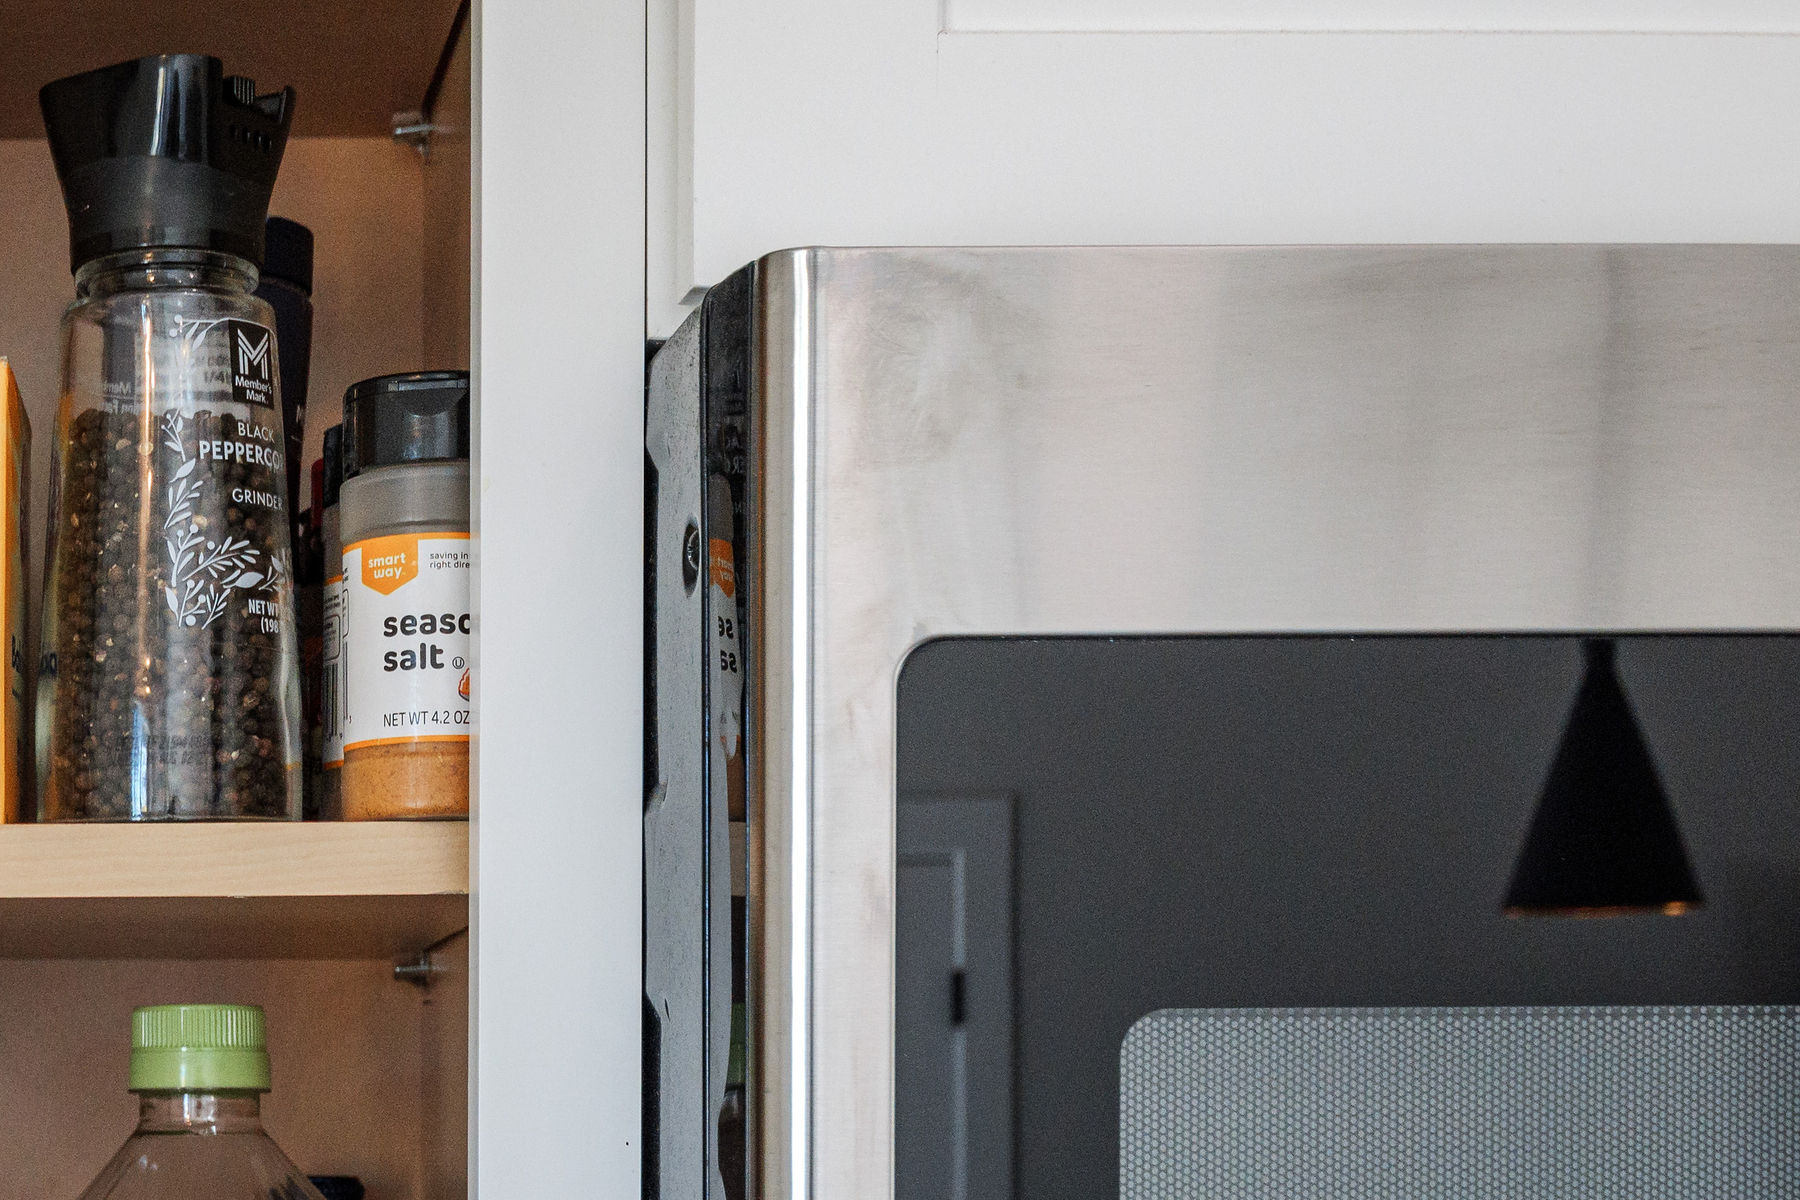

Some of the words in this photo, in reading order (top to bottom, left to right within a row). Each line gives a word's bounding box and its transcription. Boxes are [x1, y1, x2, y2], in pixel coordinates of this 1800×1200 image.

[235, 376, 272, 394] Member's
[246, 392, 266, 403] Mark
[238, 422, 275, 443] BLACK
[232, 488, 283, 510] GRINDER
[369, 552, 406, 568] smart
[430, 561, 450, 569] right
[454, 560, 470, 568] dire
[374, 565, 403, 579] way
[249, 599, 265, 615] NET
[267, 601, 279, 617] WT
[261, 617, 279, 633] (198
[384, 613, 470, 637] seaso
[384, 643, 444, 671] salt
[384, 712, 406, 727] NET
[409, 711, 428, 725] WT
[432, 711, 450, 724] 4.2
[454, 711, 469, 724] OZ
